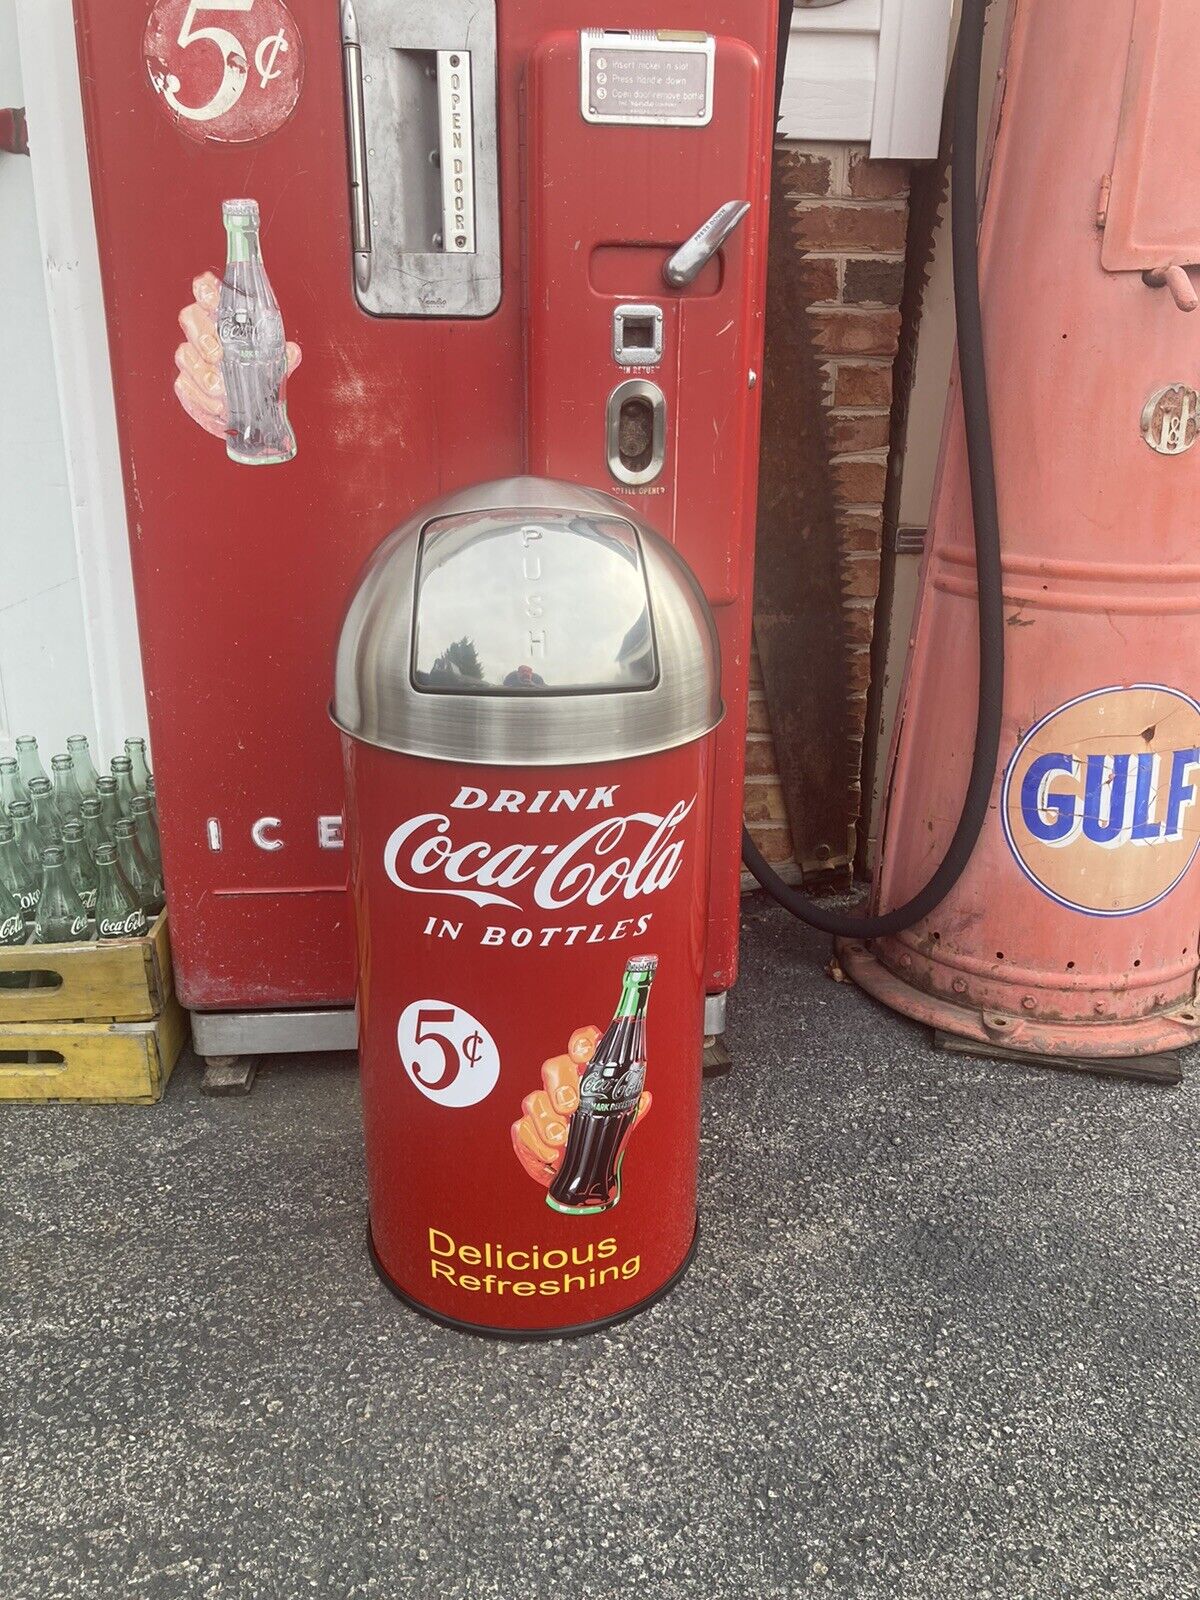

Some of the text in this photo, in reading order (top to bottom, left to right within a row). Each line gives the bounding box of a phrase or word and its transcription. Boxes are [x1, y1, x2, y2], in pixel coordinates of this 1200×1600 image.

[612, 74, 633, 83] Press
[666, 77, 687, 85] down
[450, 73, 465, 230] OPEN DOOR
[521, 528, 547, 658] PUSH
[449, 784, 621, 814] DRINK
[1020, 747, 1200, 848] GULF
[207, 815, 345, 852] ICE
[383, 792, 698, 913] Coca-Cola
[423, 912, 653, 948] IN BOTTLES
[428, 1227, 618, 1271] Delicious
[430, 1254, 641, 1297] Refreshing
